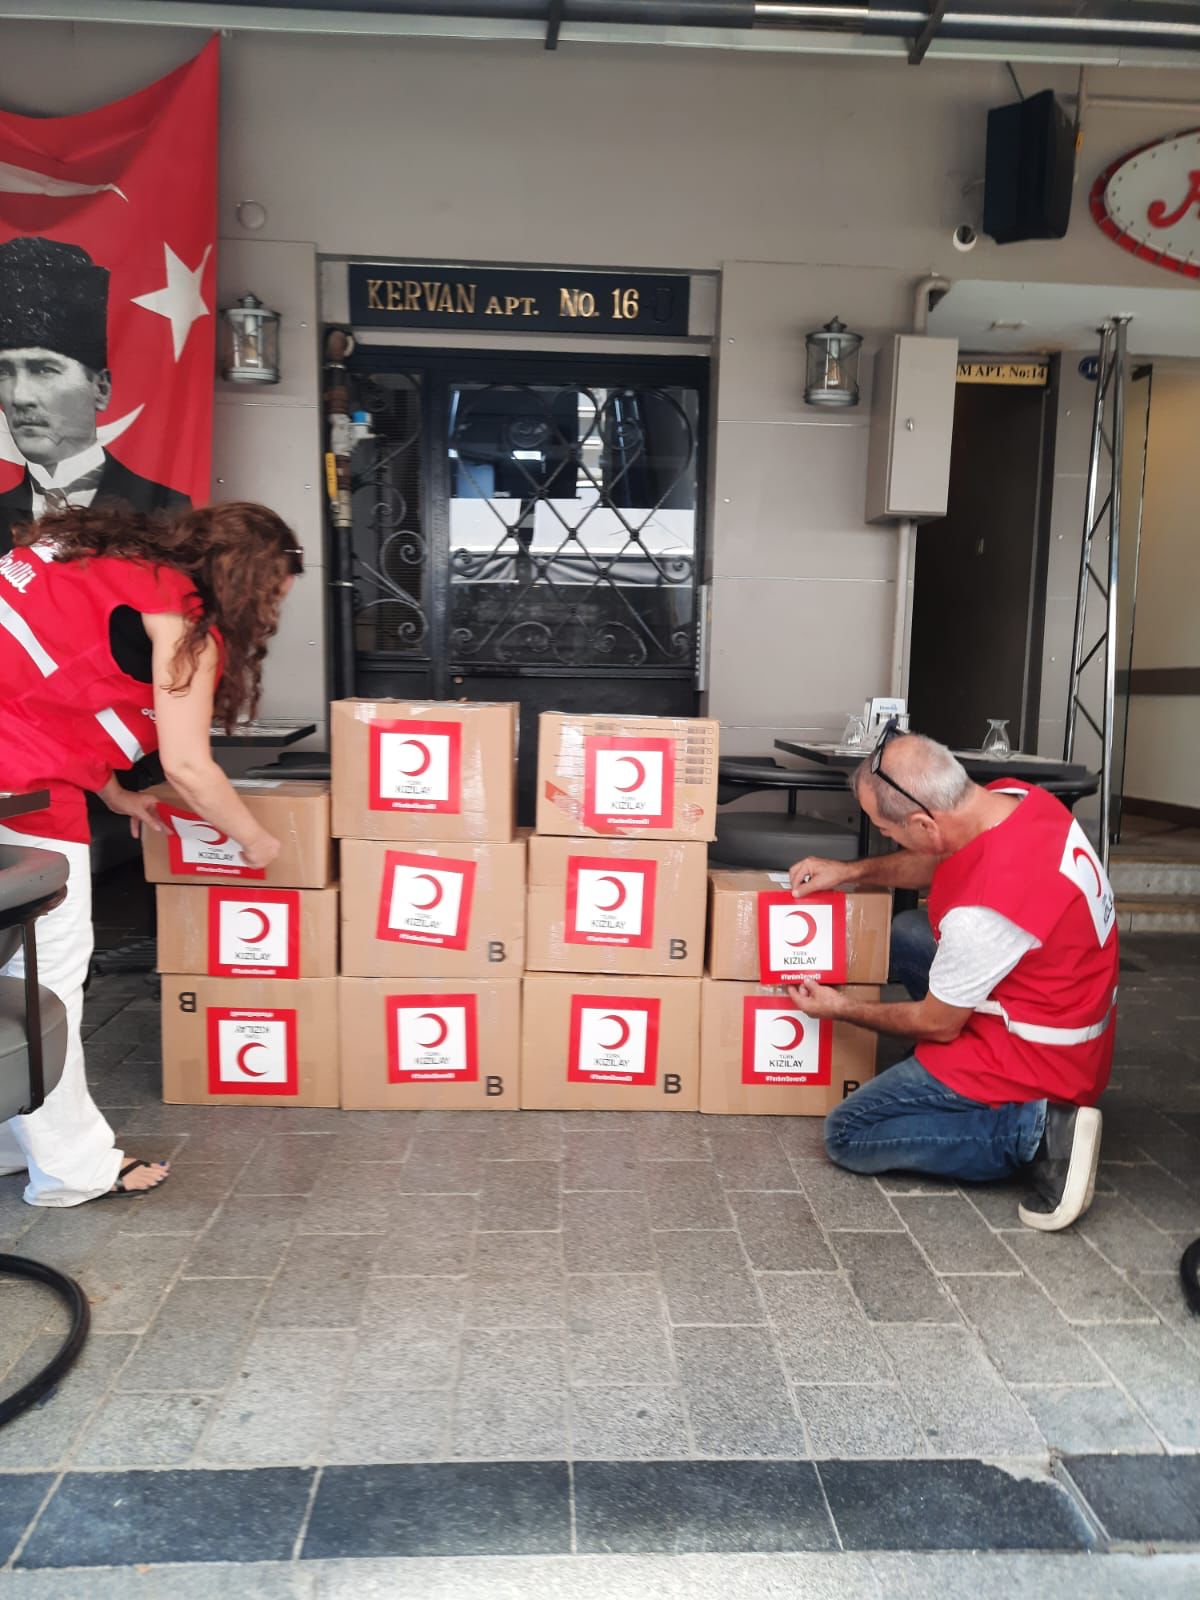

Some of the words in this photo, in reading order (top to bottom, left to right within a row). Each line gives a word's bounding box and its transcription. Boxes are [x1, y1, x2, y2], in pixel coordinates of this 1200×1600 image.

[366, 279, 477, 314] KERVAN
[484, 295, 540, 316] APT.
[559, 287, 600, 318] NO.
[611, 287, 640, 319] 16
[975, 365, 1005, 378] APT.
[1009, 366, 1045, 378] No:14
[487, 941, 506, 963] B
[669, 938, 688, 960] B
[783, 956, 817, 965] KIZILAY
[178, 992, 196, 1013] B
[769, 1060, 804, 1068] KIZILAY
[485, 1075, 504, 1097] B
[663, 1073, 682, 1095] B
